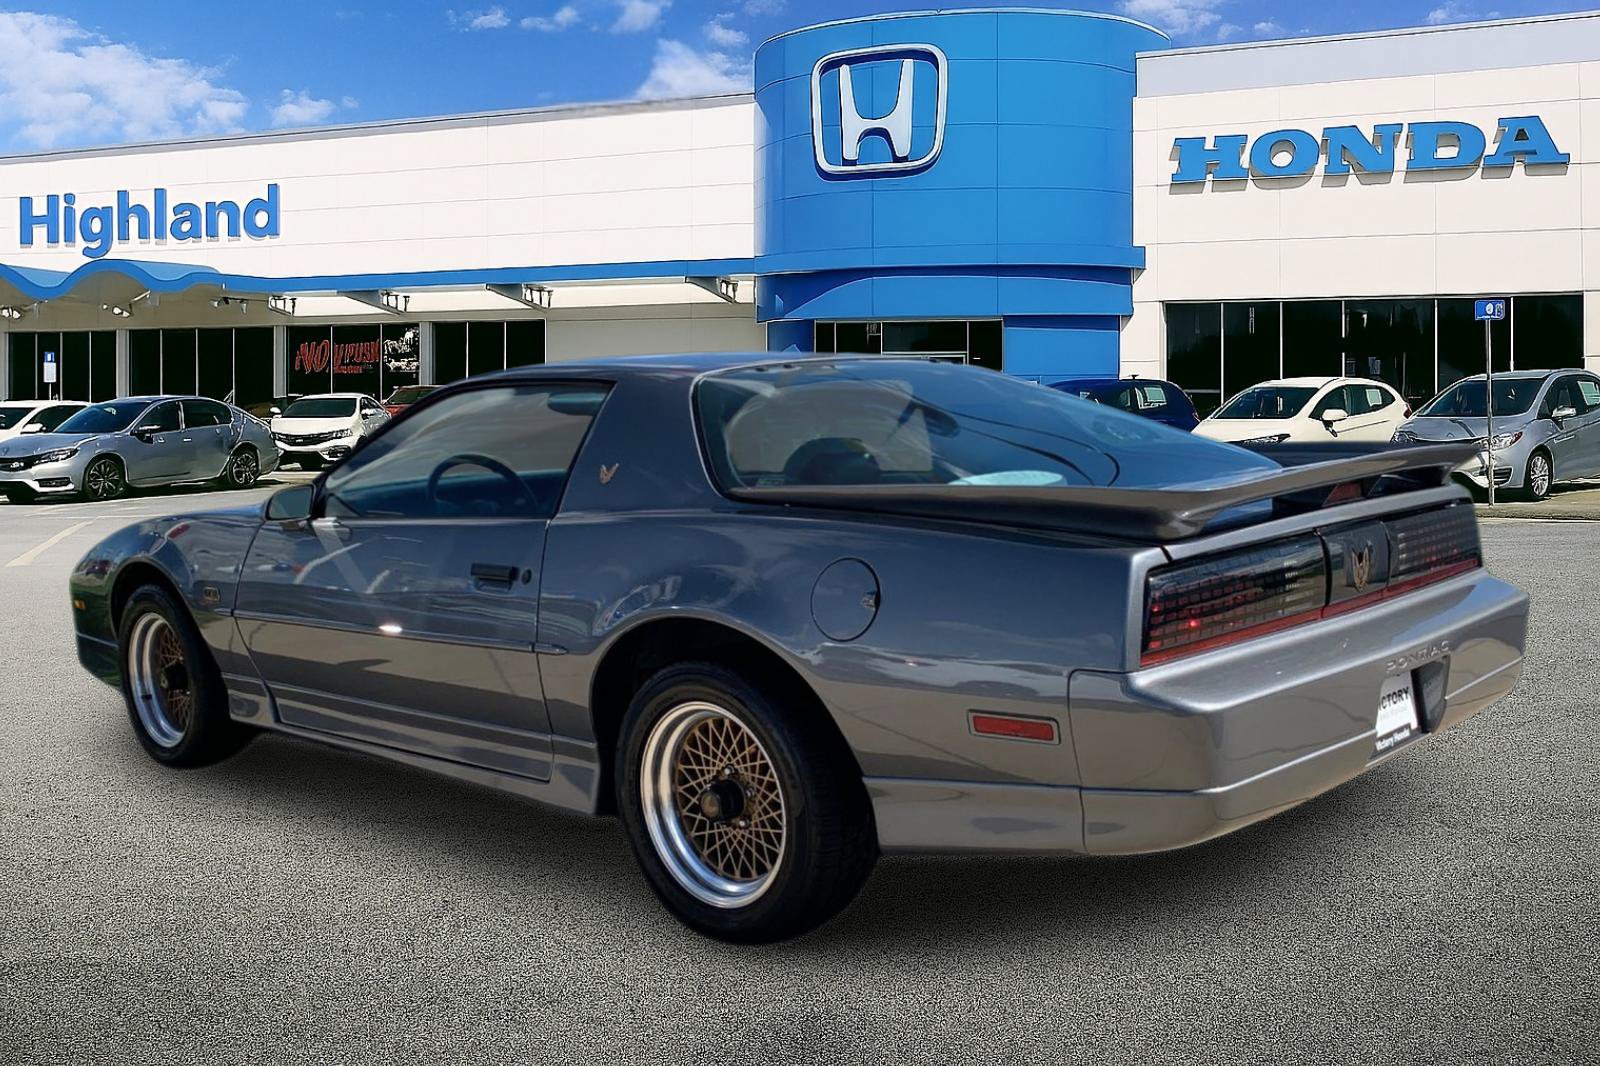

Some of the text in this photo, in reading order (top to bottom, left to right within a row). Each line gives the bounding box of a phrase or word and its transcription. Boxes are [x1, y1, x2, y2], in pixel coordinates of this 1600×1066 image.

[1171, 115, 1570, 184] HONDA
[19, 183, 279, 258] Highland
[1386, 640, 1449, 672] PONTIAC
